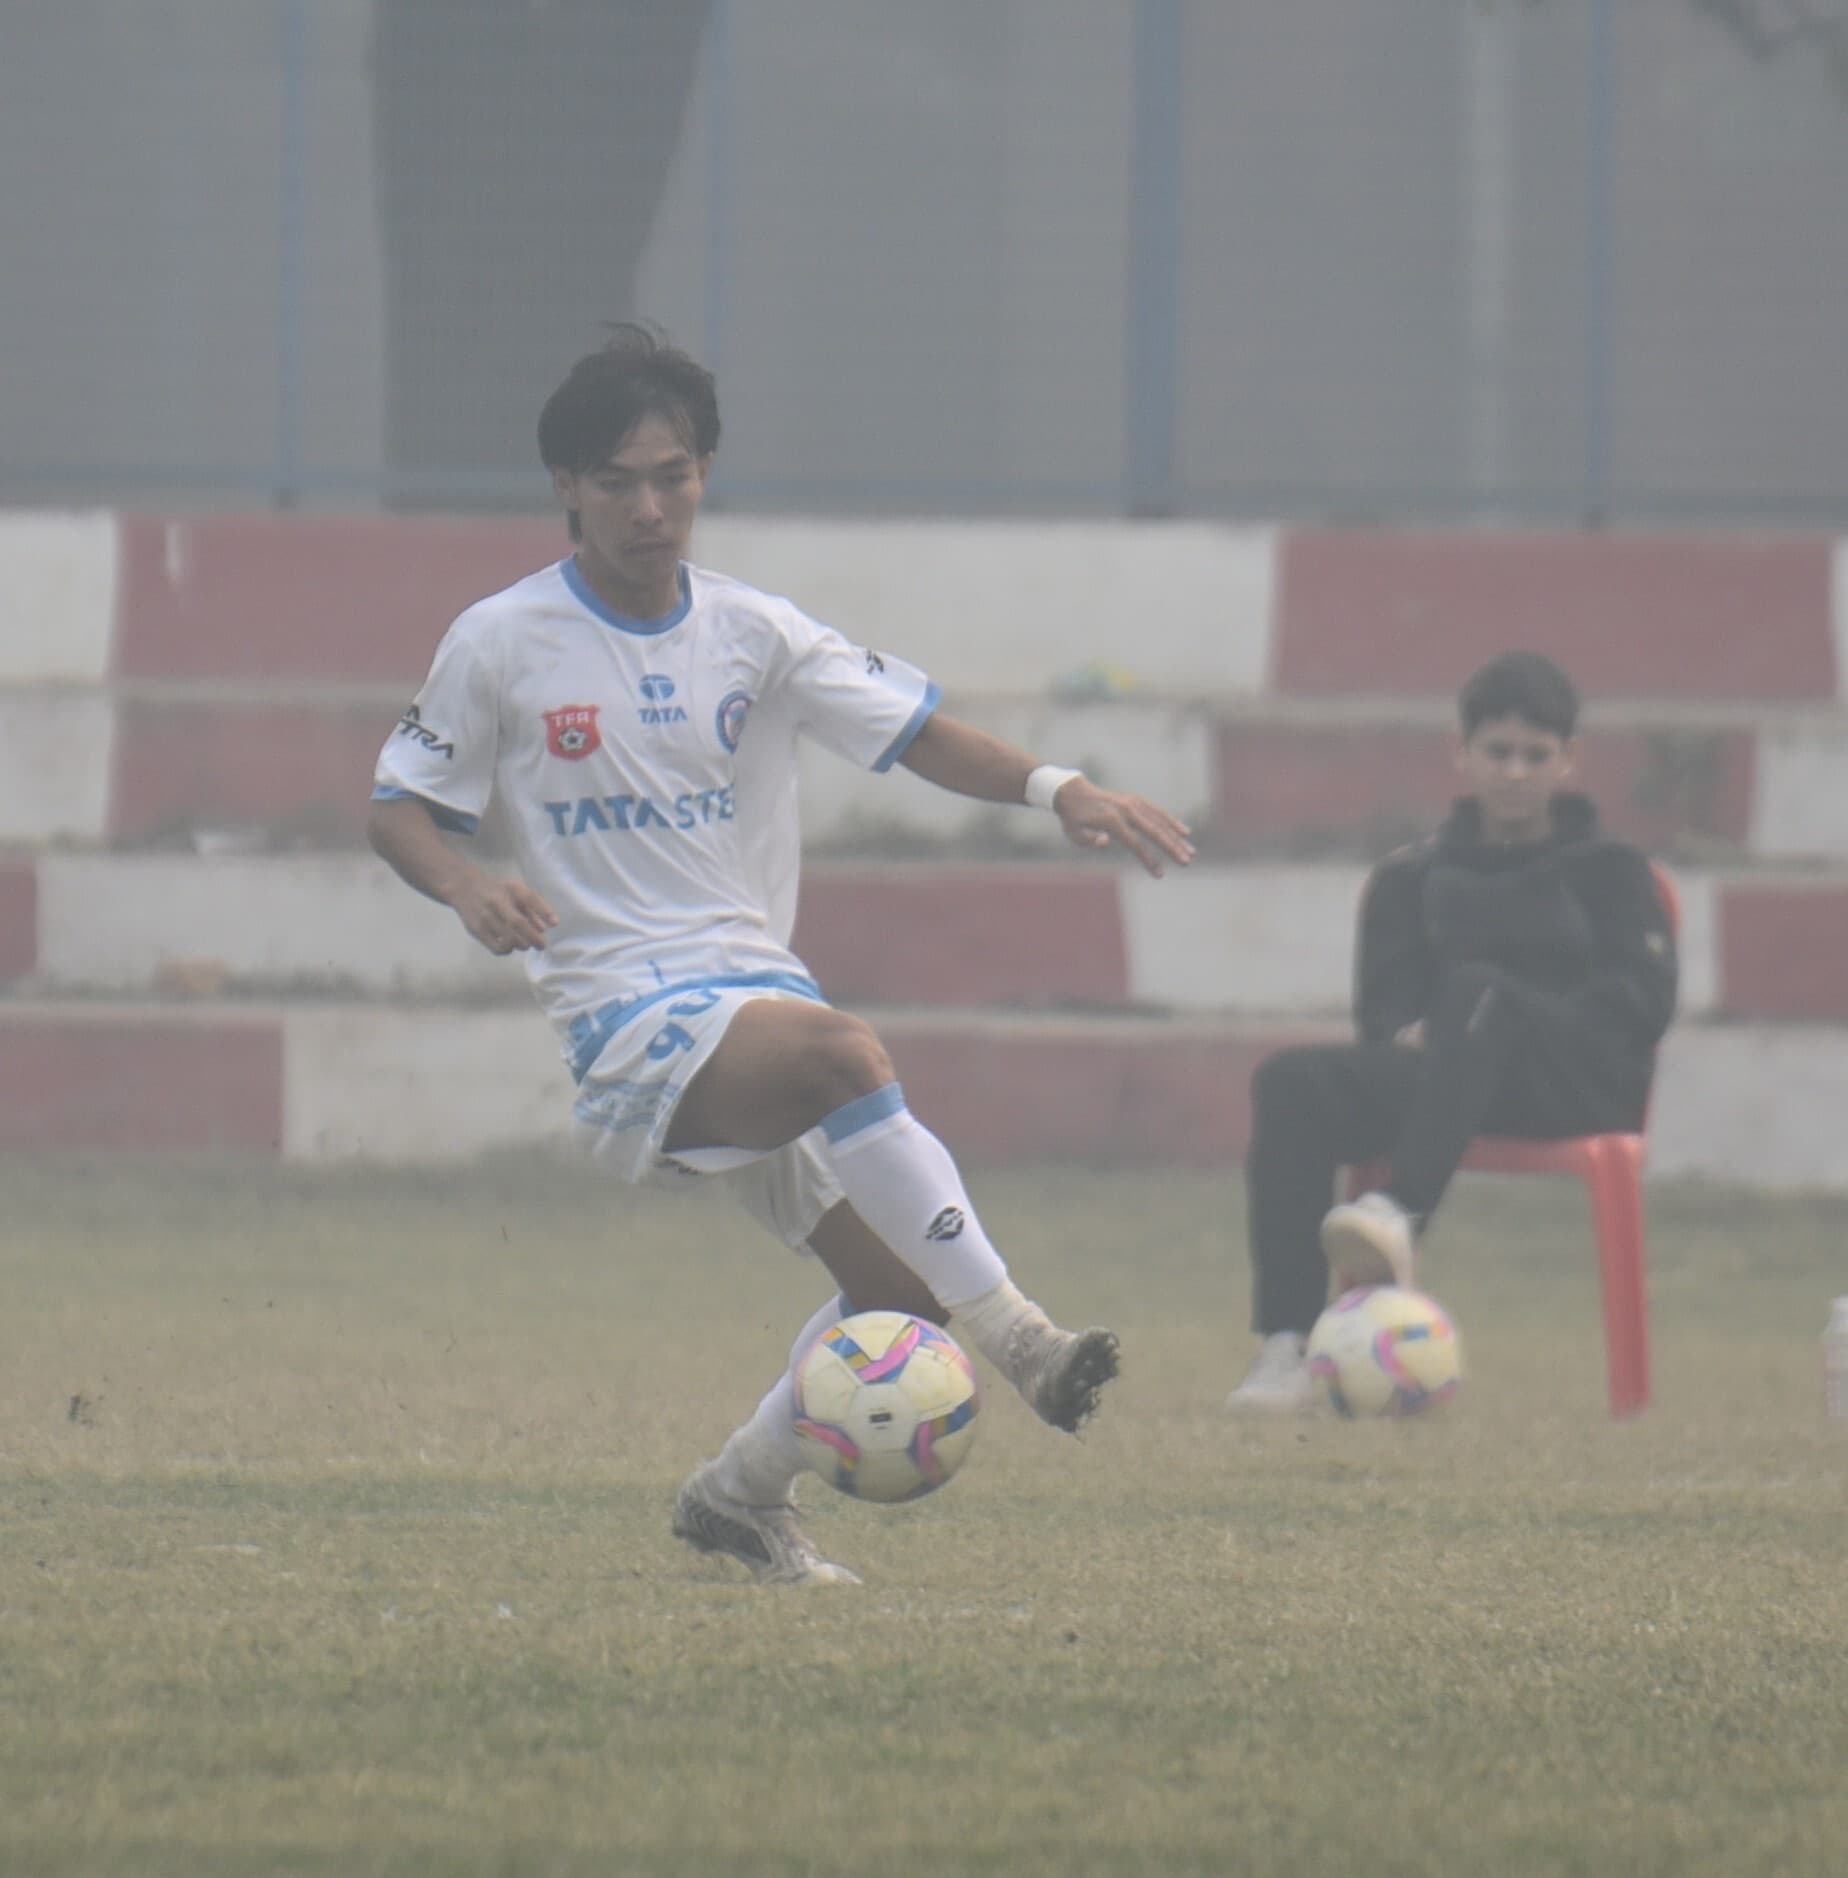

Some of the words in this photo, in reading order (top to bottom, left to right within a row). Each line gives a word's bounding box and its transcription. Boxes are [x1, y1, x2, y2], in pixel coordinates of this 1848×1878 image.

[551, 711, 590, 728] TFA
[637, 706, 688, 725] TATA
[543, 794, 672, 836] TATA
